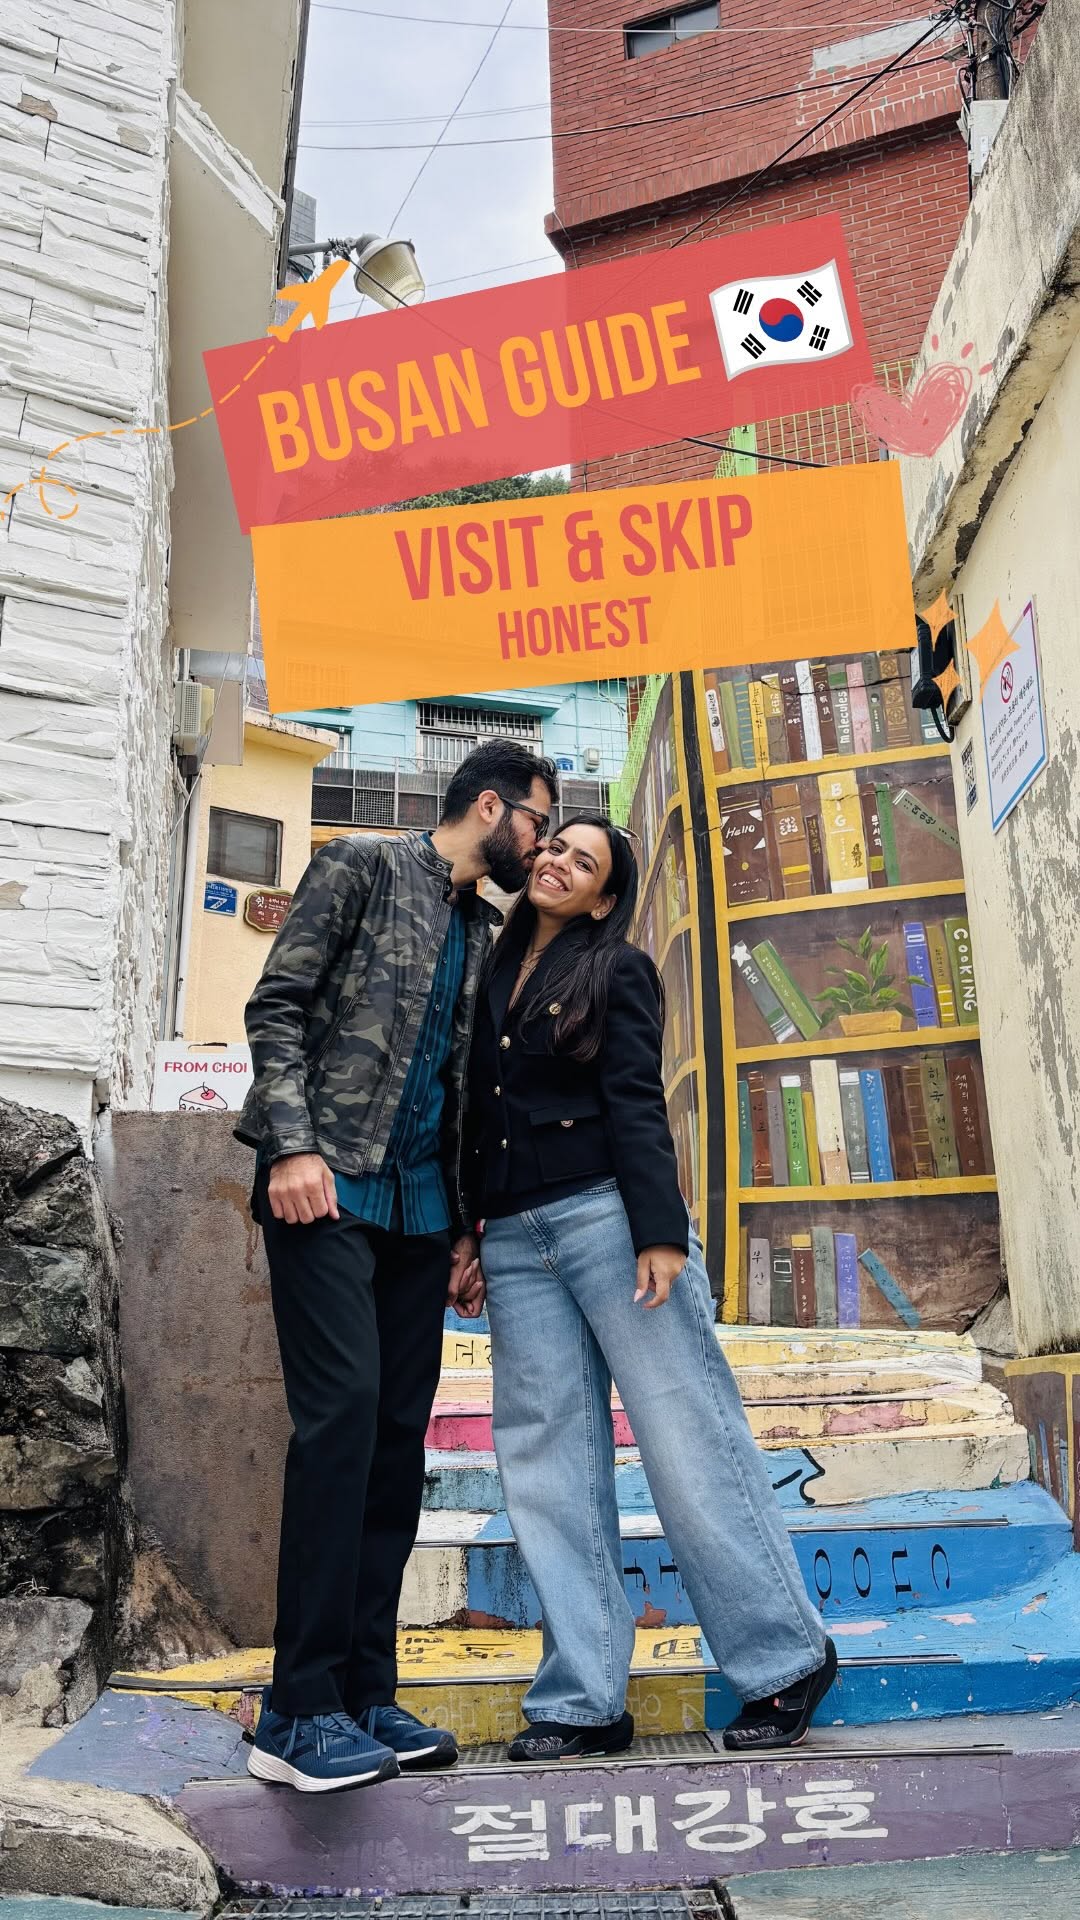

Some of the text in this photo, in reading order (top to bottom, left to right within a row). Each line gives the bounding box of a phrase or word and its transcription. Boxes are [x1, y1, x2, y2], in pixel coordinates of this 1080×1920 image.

[830, 782, 847, 828] BIG
[725, 824, 756, 839] Hello
[163, 1061, 247, 1073] FROM CHOI
[450, 1778, 890, 1863] 절대강호
